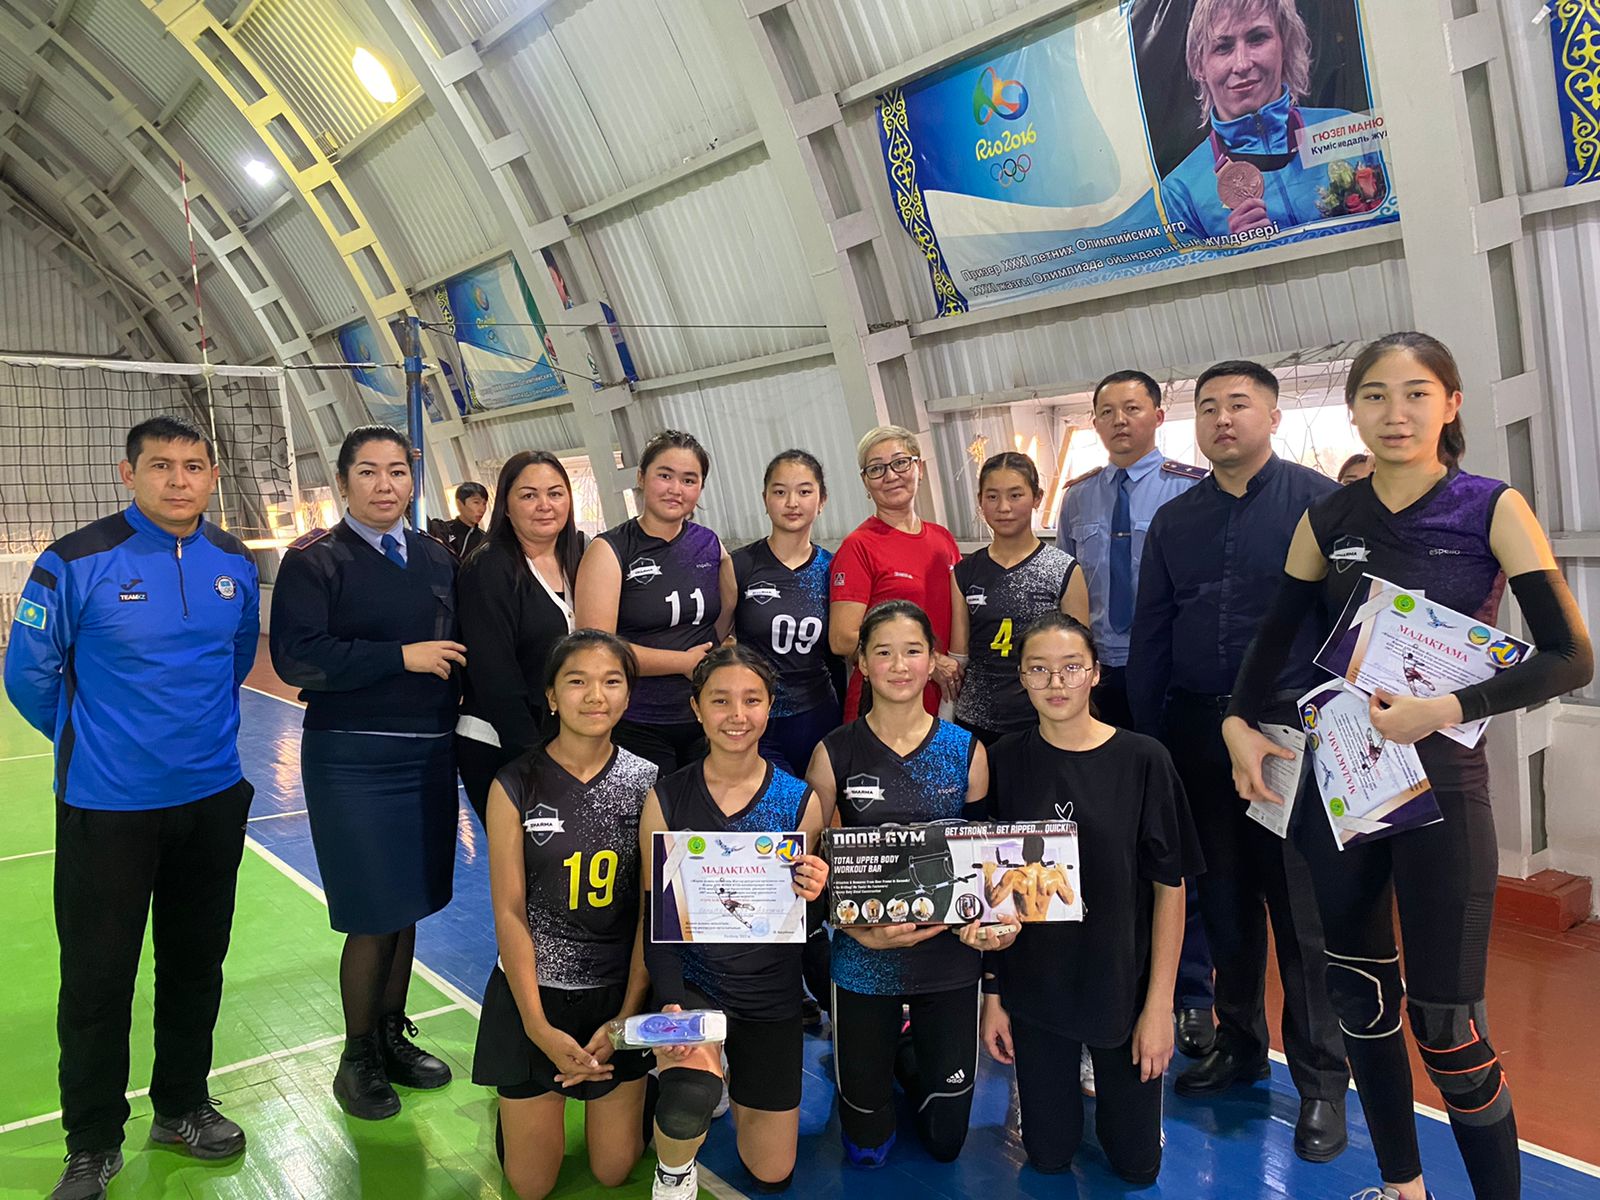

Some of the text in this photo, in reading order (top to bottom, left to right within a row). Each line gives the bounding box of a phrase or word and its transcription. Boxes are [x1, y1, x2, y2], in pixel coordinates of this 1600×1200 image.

[1348, 117, 1384, 134] МАНЮ
[961, 266, 1001, 282] Призер
[1032, 245, 1075, 265] летних
[1075, 226, 1161, 251] Олимпийских
[1163, 220, 1187, 235] игр
[1032, 259, 1104, 283] Олимпиада
[665, 587, 705, 628] 11
[771, 614, 823, 654] 09
[990, 618, 1013, 657] 4
[832, 830, 926, 849] DOOR GYM
[945, 827, 958, 836] GET
[996, 825, 1010, 834] GET
[1045, 823, 1069, 833] QUICK!
[834, 855, 900, 865] TOTAL UPPER BODY
[834, 864, 882, 874] WORKOUT BAR
[563, 849, 619, 911] 19
